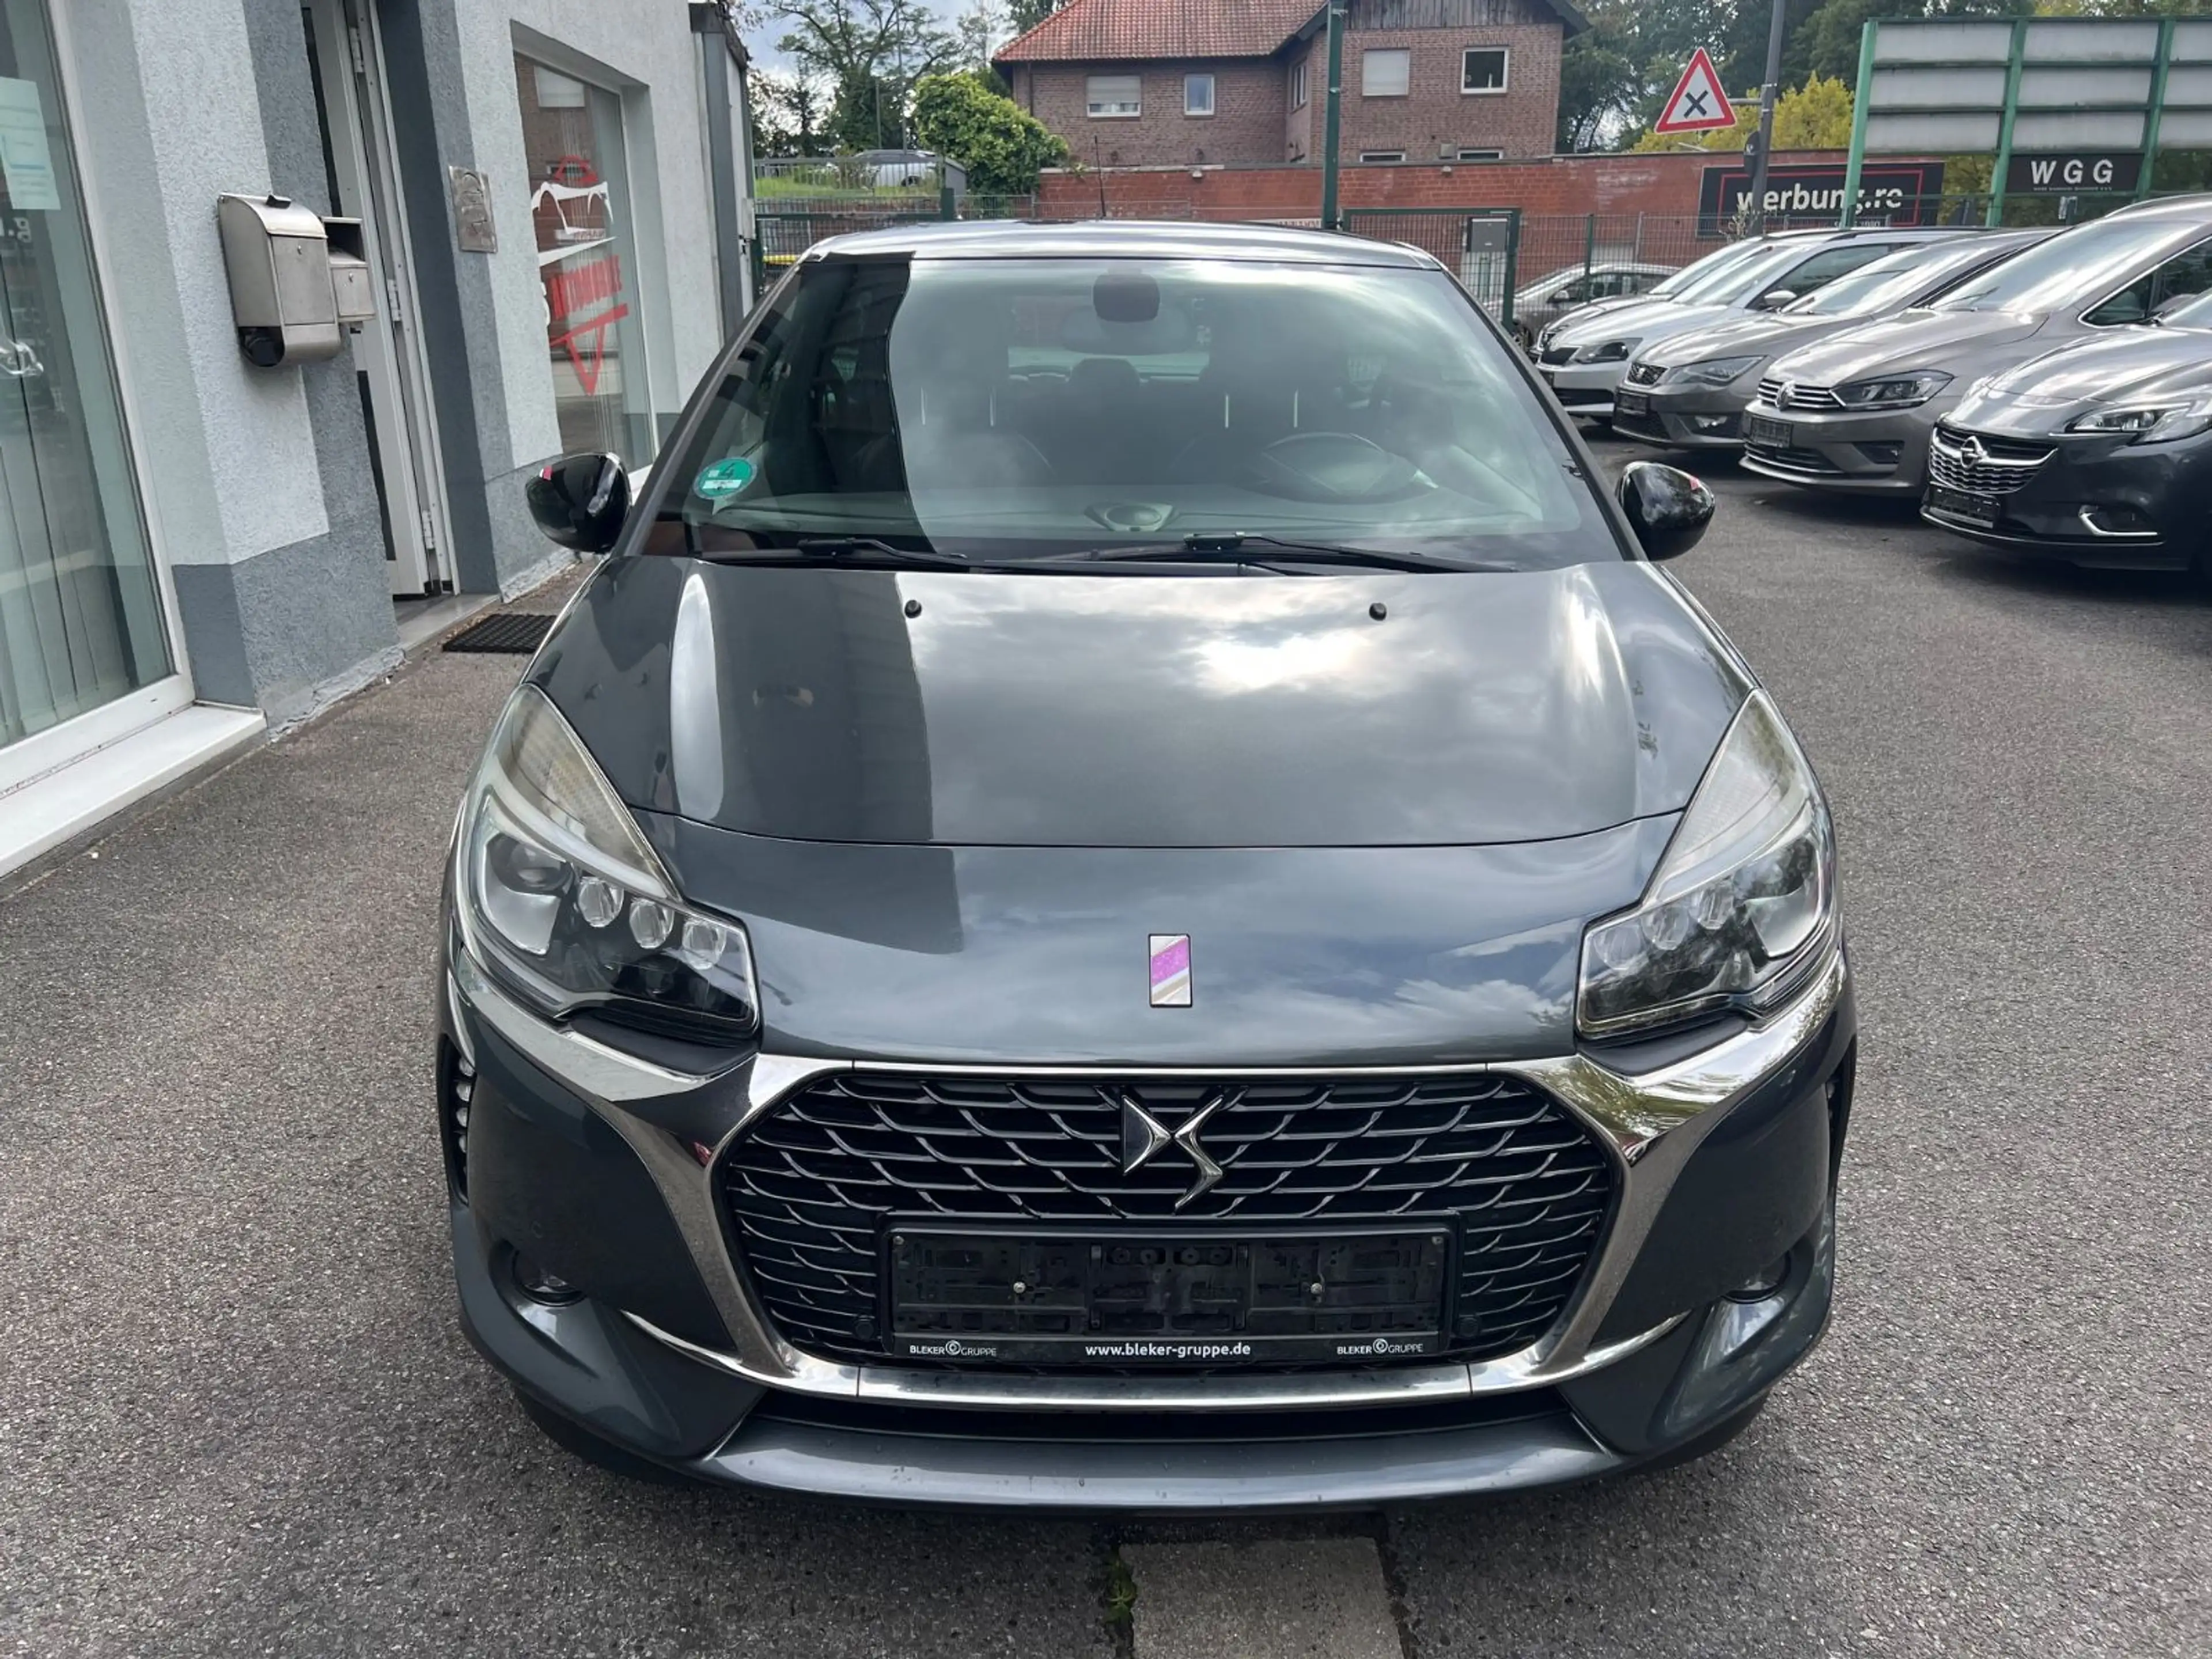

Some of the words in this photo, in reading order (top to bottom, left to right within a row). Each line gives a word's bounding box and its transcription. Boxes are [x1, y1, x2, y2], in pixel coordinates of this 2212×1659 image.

[910, 1345, 945, 1354] BLEKER
[961, 1347, 997, 1357] GRUPPE
[1085, 1342, 1251, 1358] www.bleker-gruppe.de
[1337, 1346, 1372, 1354] BLEKER
[1388, 1343, 1423, 1353] GRUPPE
